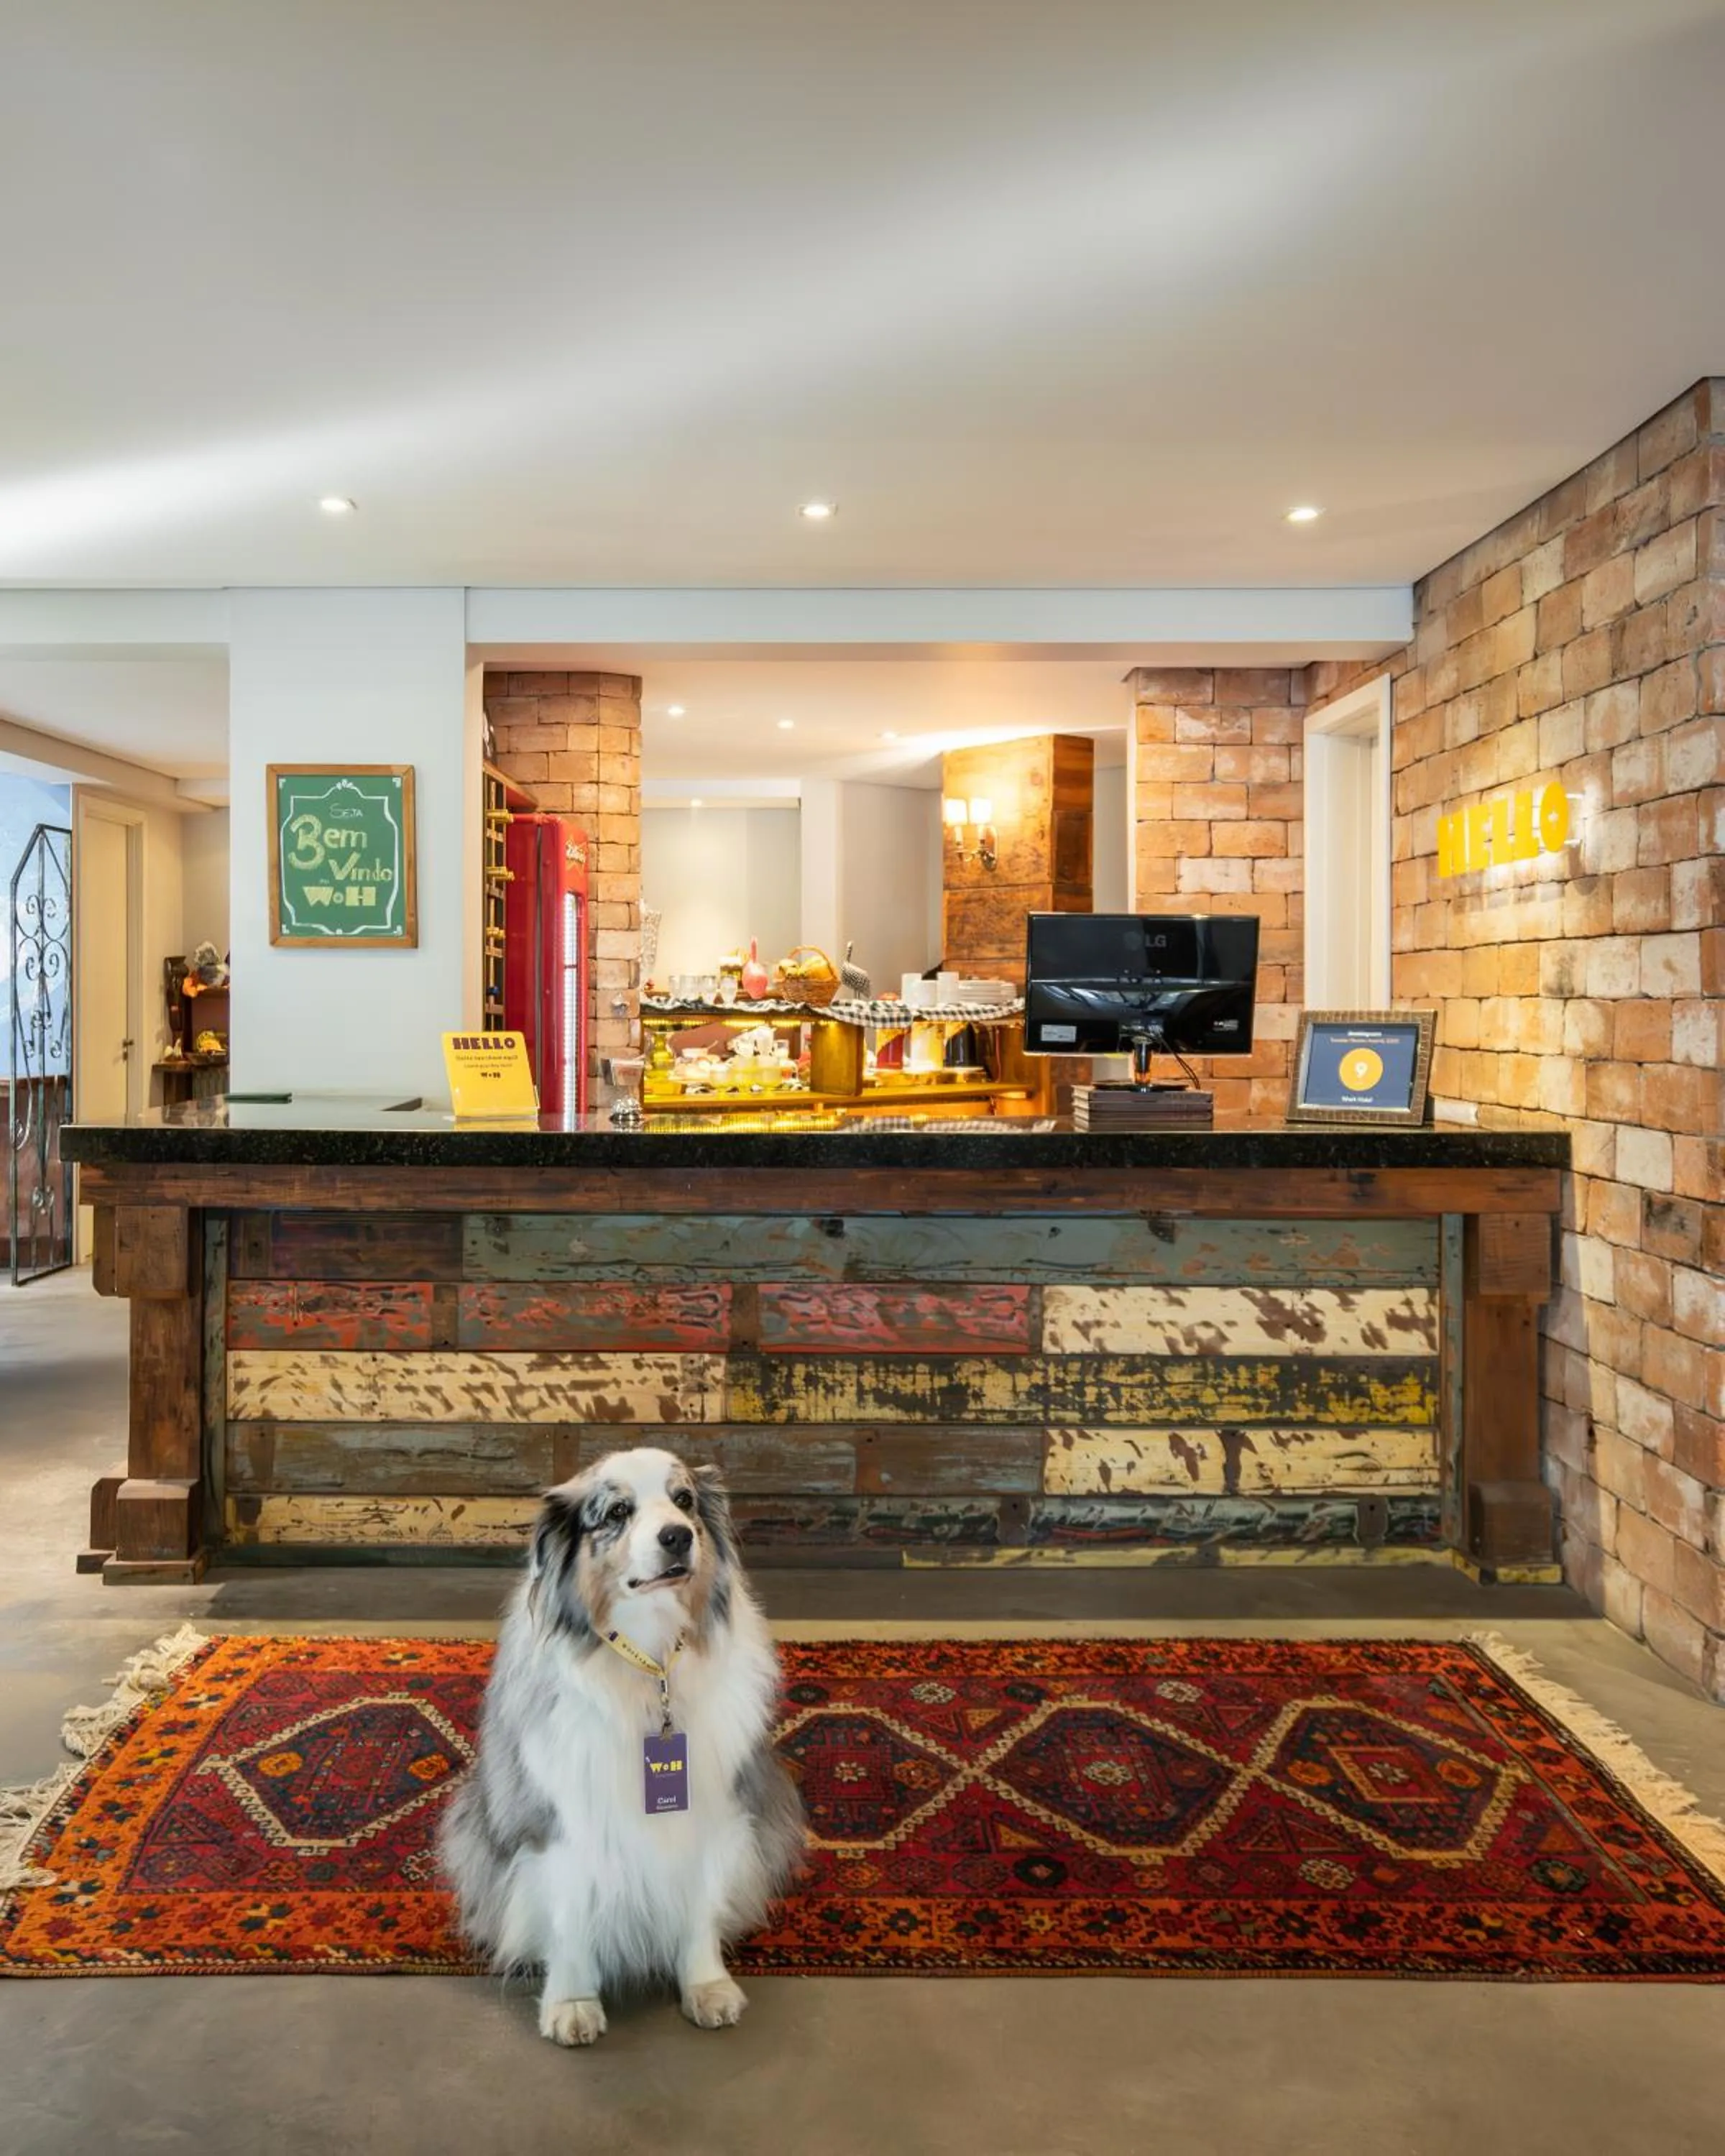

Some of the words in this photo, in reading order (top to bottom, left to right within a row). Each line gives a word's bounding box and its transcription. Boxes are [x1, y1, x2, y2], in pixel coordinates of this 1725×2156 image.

[288, 814, 367, 870] Bem
[1438, 781, 1568, 879] HELLO
[328, 852, 392, 881] Vindo
[1145, 935, 1166, 947] LG
[452, 1037, 515, 1049] HELLO
